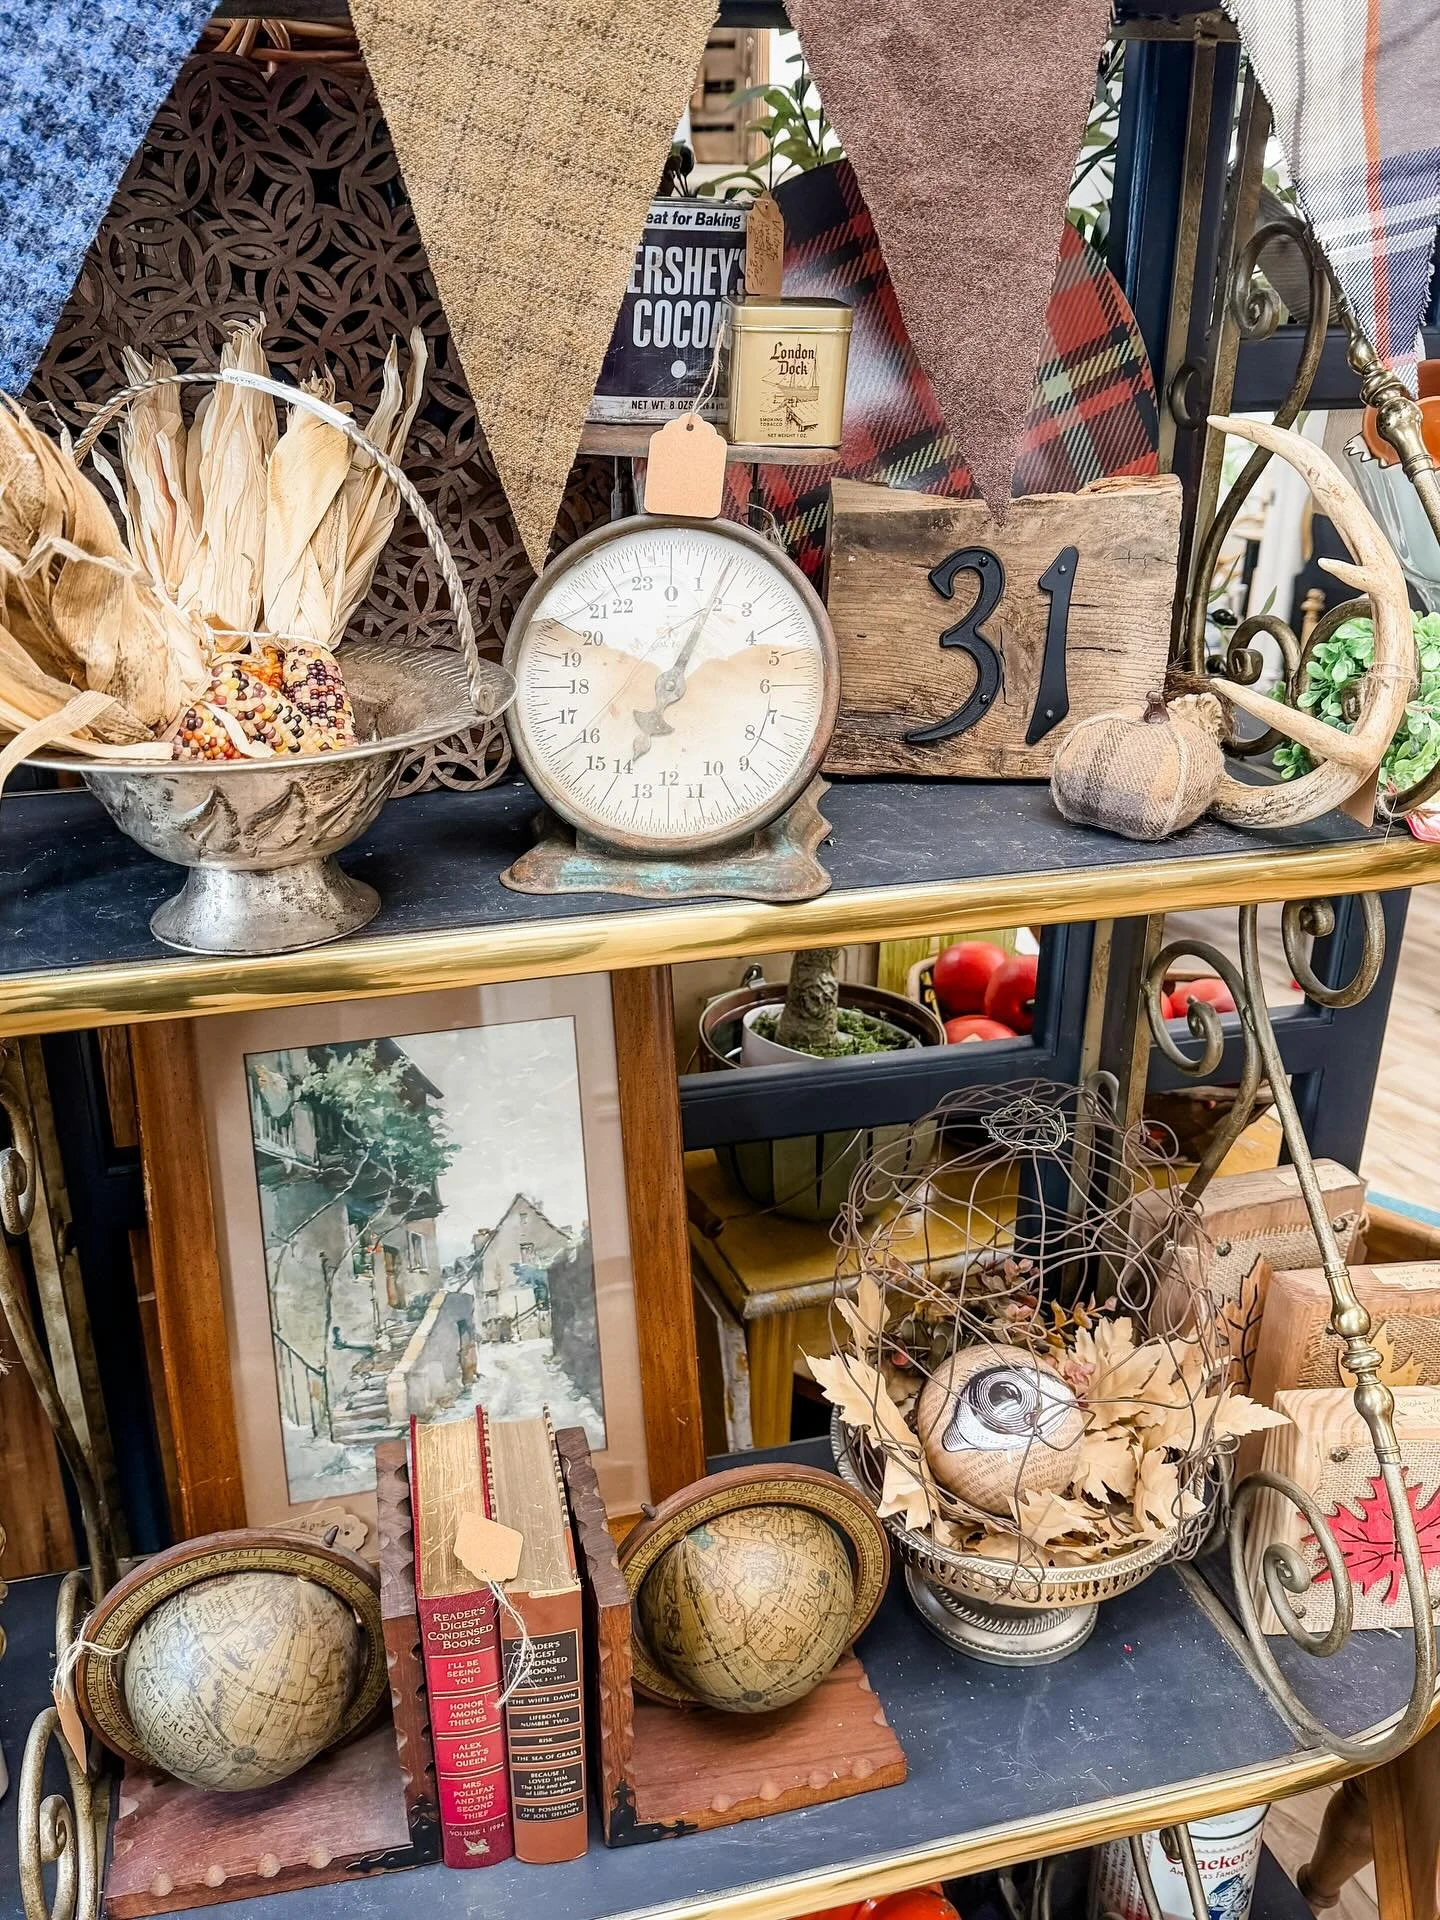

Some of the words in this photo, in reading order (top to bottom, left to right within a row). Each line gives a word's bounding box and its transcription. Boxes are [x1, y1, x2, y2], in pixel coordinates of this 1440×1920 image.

[646, 212, 668, 225] eat
[672, 211, 692, 225] for
[695, 211, 741, 230] Baking
[626, 245, 747, 296] ERSHEY'
[770, 341, 816, 360] London
[777, 360, 808, 375] Dock
[631, 400, 648, 410] NET
[651, 400, 666, 410] WT.
[669, 400, 675, 410] 8
[632, 576, 653, 591] 23
[694, 577, 704, 592] 1
[664, 586, 678, 602] 0
[589, 604, 608, 619] 21
[612, 599, 633, 614] 22
[712, 598, 723, 612] 2
[742, 602, 752, 617] 3
[582, 630, 604, 646] 20
[745, 630, 757, 646] 4
[562, 652, 582, 668] 19
[768, 650, 780, 666] 5
[569, 678, 589, 694] 18
[760, 679, 770, 694] 6
[559, 709, 578, 725] 17
[768, 710, 778, 724] 7
[580, 728, 600, 744] 16
[744, 724, 756, 740] 8
[586, 755, 606, 770] 15
[613, 759, 633, 774] 14
[704, 760, 724, 776] 10
[739, 756, 750, 771] 9
[658, 770, 679, 786] 12
[632, 784, 652, 799] 13
[685, 784, 705, 798] 11
[433, 1606, 486, 1622] READER'S
[427, 1624, 494, 1640] CONDENSED
[440, 1618, 481, 1631] DIGEST
[443, 1637, 481, 1649] BOOKS
[521, 1656, 568, 1668] ONDENSED
[447, 1667, 481, 1677] SEEING
[553, 1693, 576, 1701] DAWN
[450, 1700, 484, 1710] HONOR
[448, 1715, 487, 1726] THIEVES
[450, 1708, 484, 1718] AMONG
[452, 1748, 488, 1759] HALEY'S
[459, 1742, 482, 1751] ALEX
[556, 1750, 577, 1758] GRASS
[456, 1756, 487, 1767] QUEEN
[454, 1784, 495, 1798] POLLIFAX
[476, 1792, 494, 1802] THE
[457, 1801, 494, 1812] SECOND
[538, 1802, 576, 1812] POSSESSION
[552, 1807, 579, 1817] DELANEY
[462, 1810, 489, 1820] THIEF
